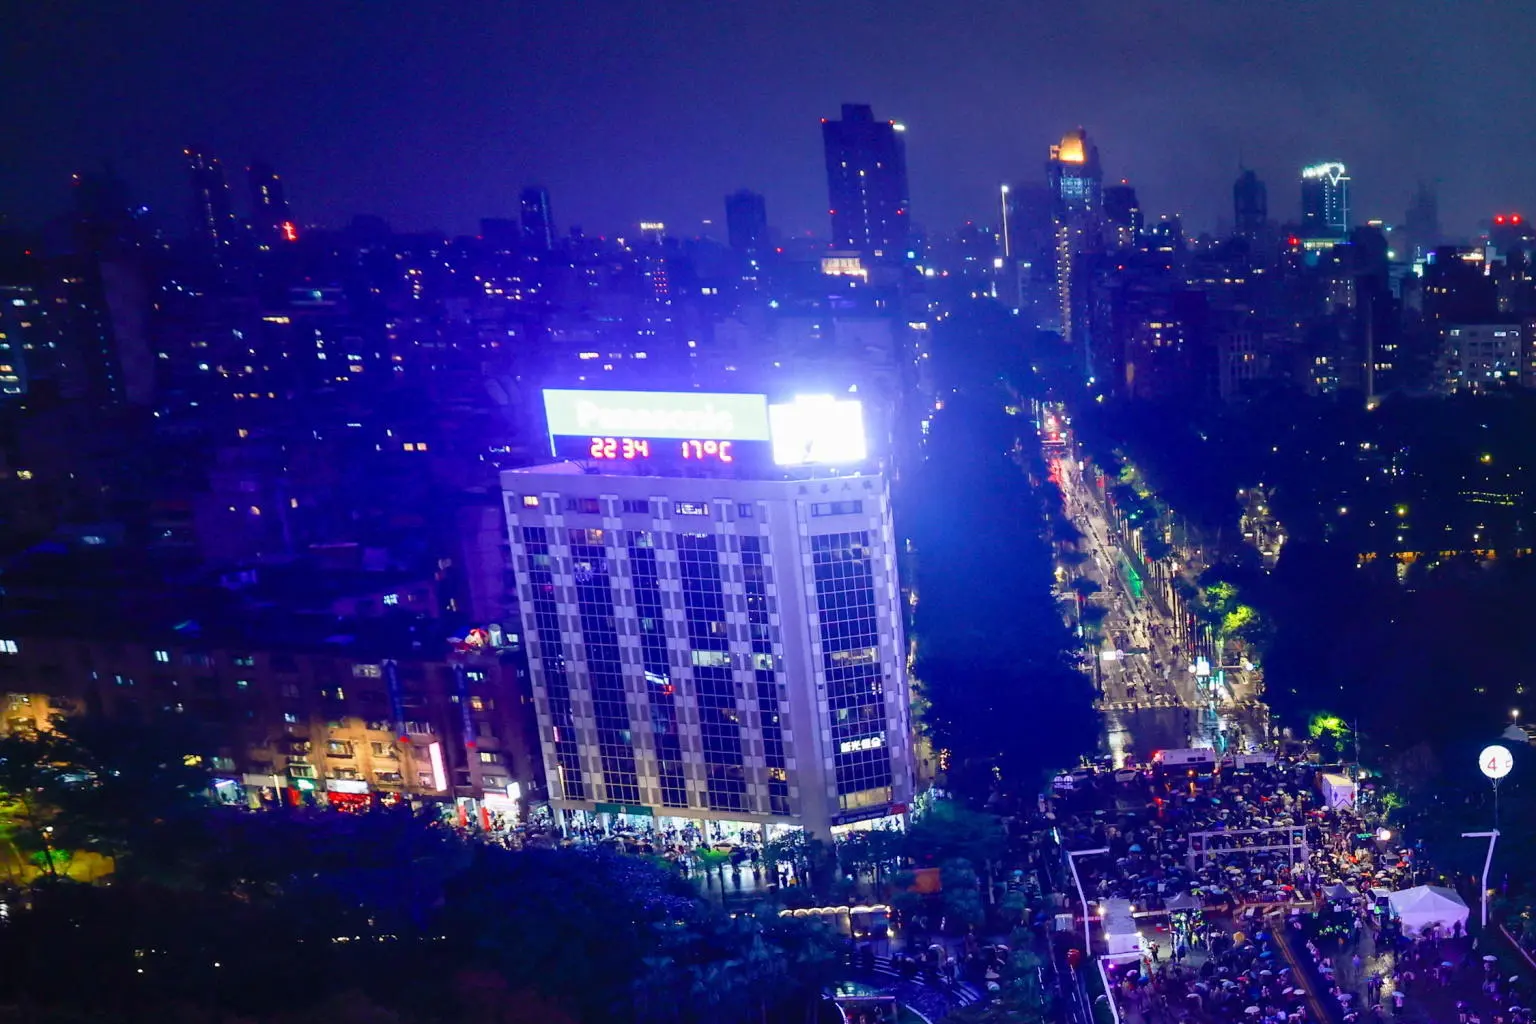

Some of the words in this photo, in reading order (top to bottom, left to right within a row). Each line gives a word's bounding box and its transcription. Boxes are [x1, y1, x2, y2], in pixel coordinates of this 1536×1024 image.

[576, 401, 734, 432] Panasonic
[591, 438, 616, 458] 22
[623, 438, 648, 459] 34
[682, 440, 732, 462] 17°C
[1487, 757, 1498, 772] 4
